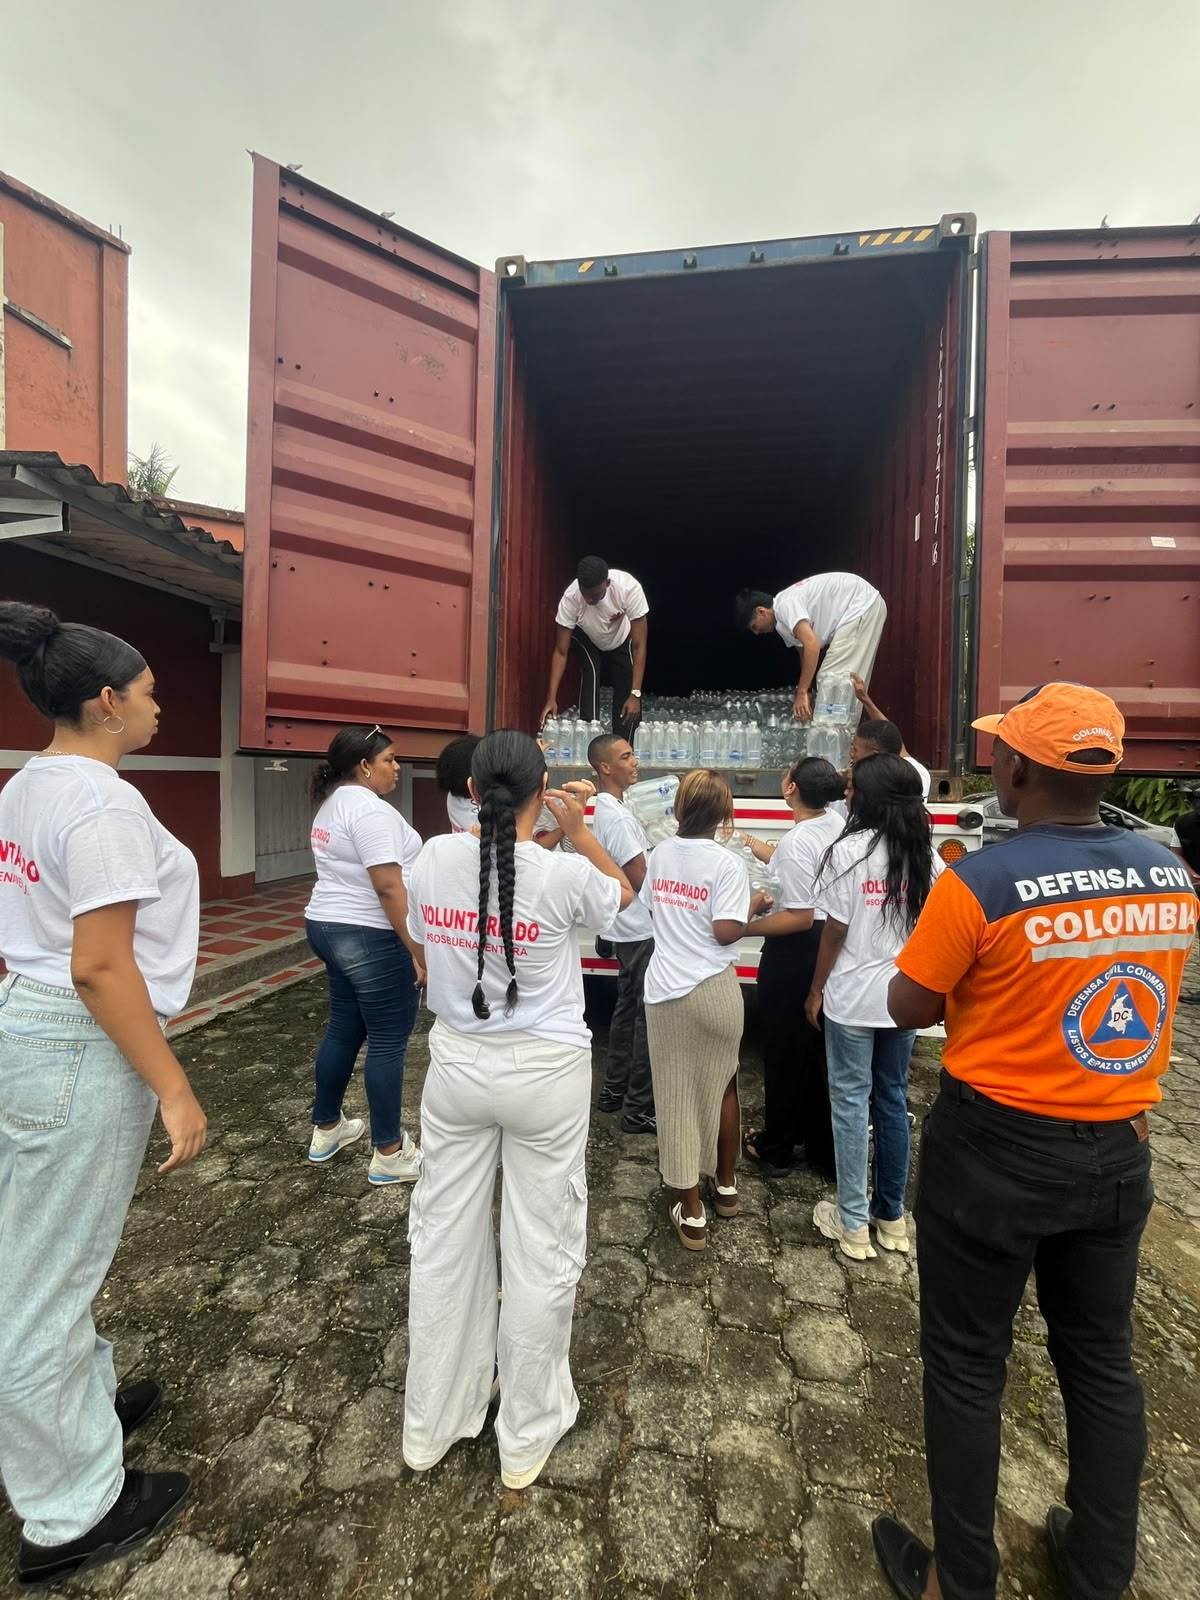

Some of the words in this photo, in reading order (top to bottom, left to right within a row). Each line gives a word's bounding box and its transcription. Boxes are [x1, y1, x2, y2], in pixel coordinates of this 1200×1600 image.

[1014, 867, 1147, 902] DEFENSA
[1066, 977, 1104, 1017] DEFENSA
[1104, 964, 1124, 980] CIVIL
[1113, 1010, 1129, 1023] DC
[1067, 1029, 1089, 1059] LISTOS
[1113, 1062, 1122, 1071] O
